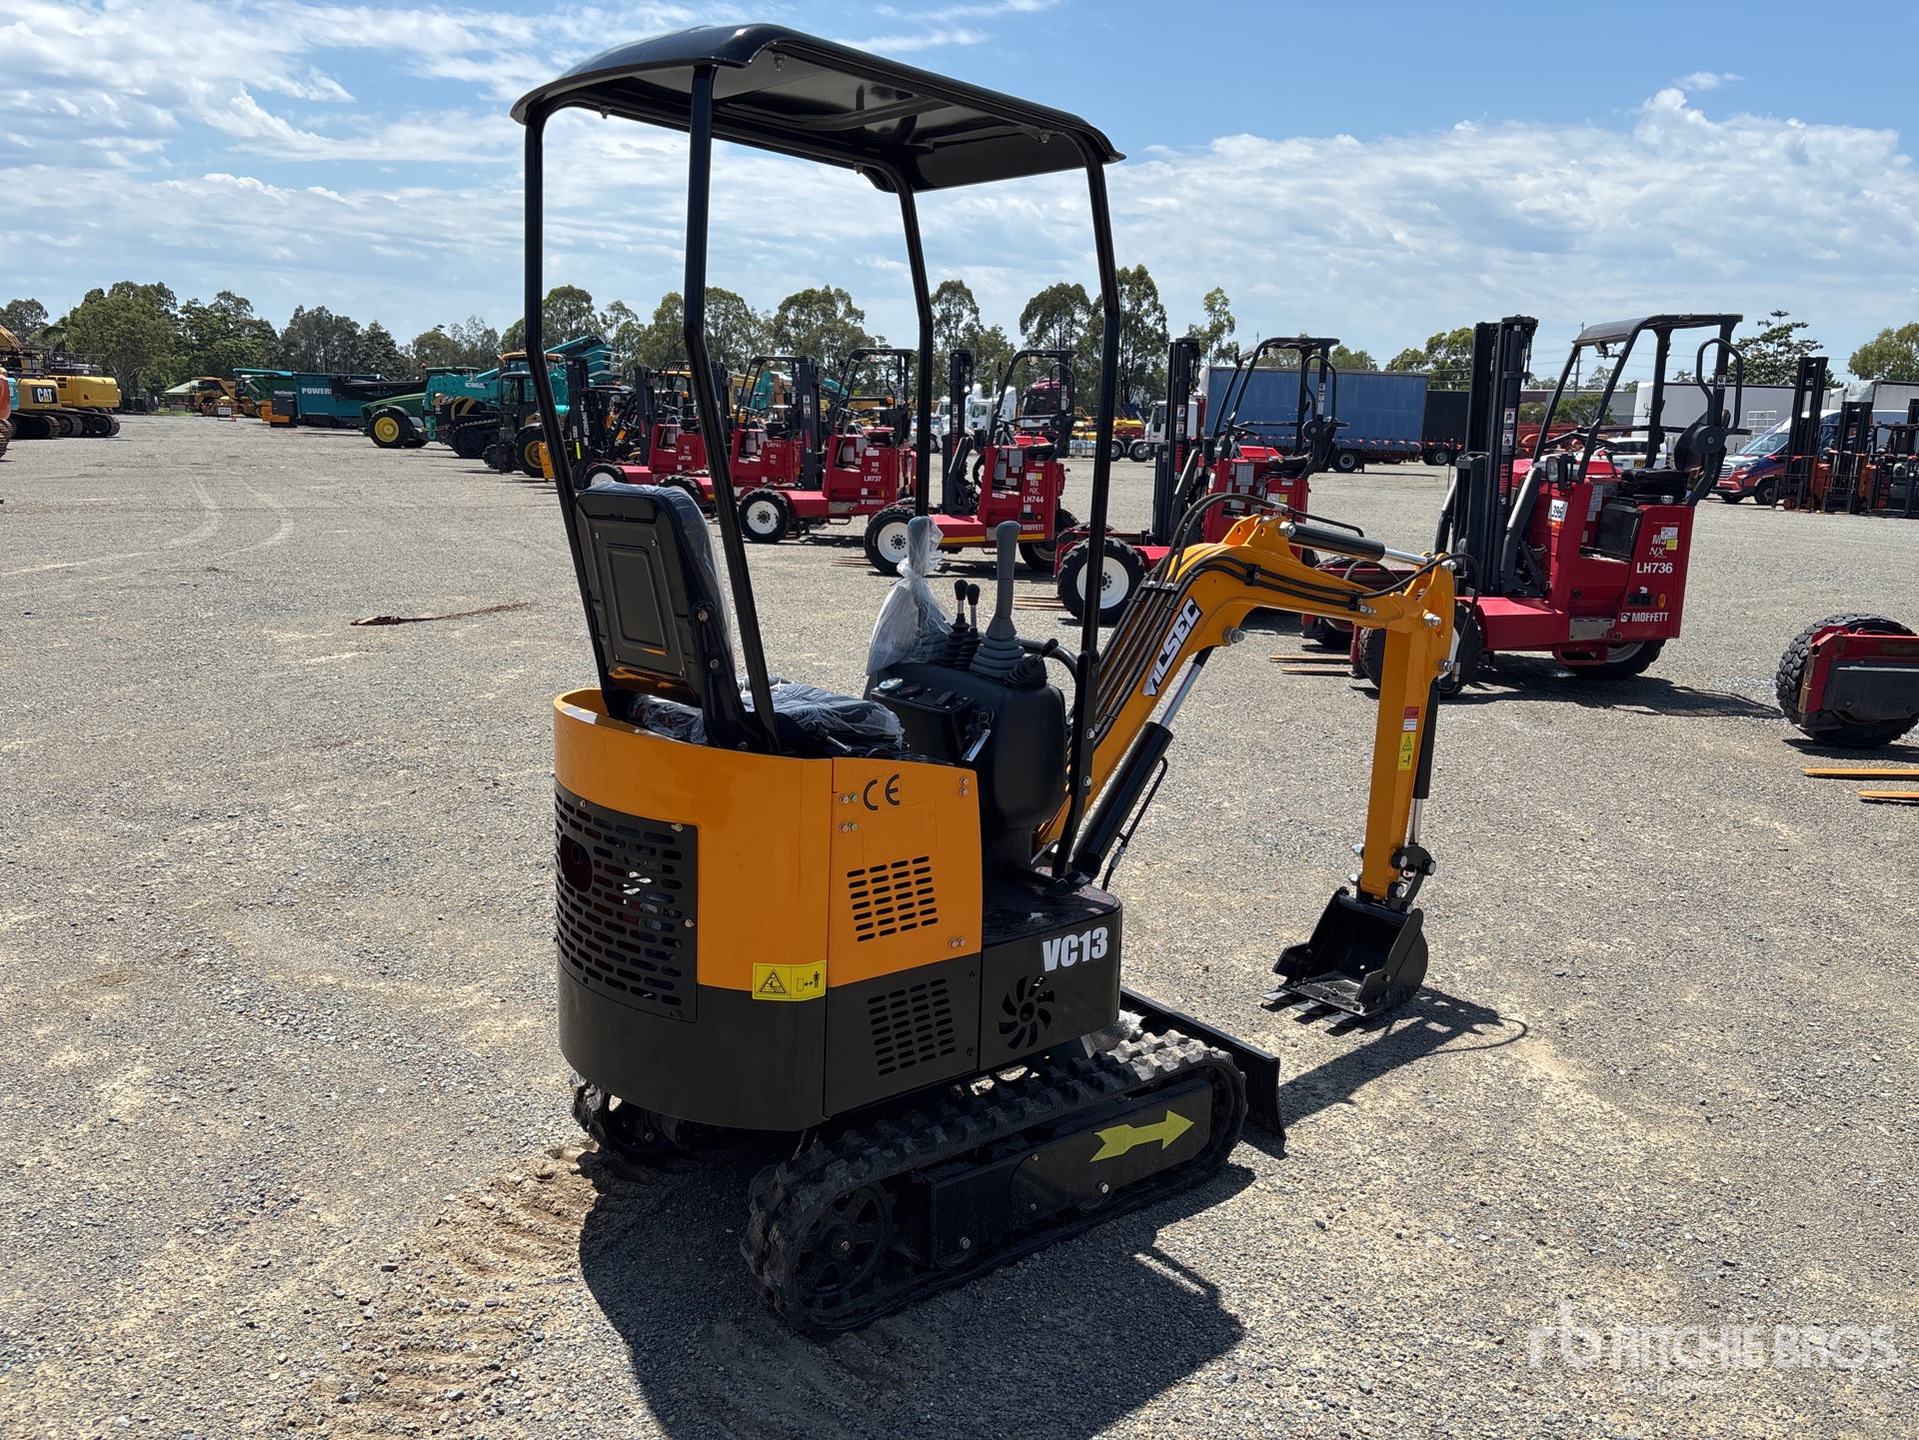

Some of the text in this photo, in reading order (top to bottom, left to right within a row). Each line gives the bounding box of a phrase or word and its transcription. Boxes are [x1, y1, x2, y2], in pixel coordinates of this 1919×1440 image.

[37, 388, 53, 403] CAT
[1022, 495, 1045, 503] LH744
[1635, 562, 1674, 574] LH736
[1630, 612, 1670, 623] MOFFETT
[862, 773, 901, 812] CE
[1042, 926, 1109, 972] VC13
